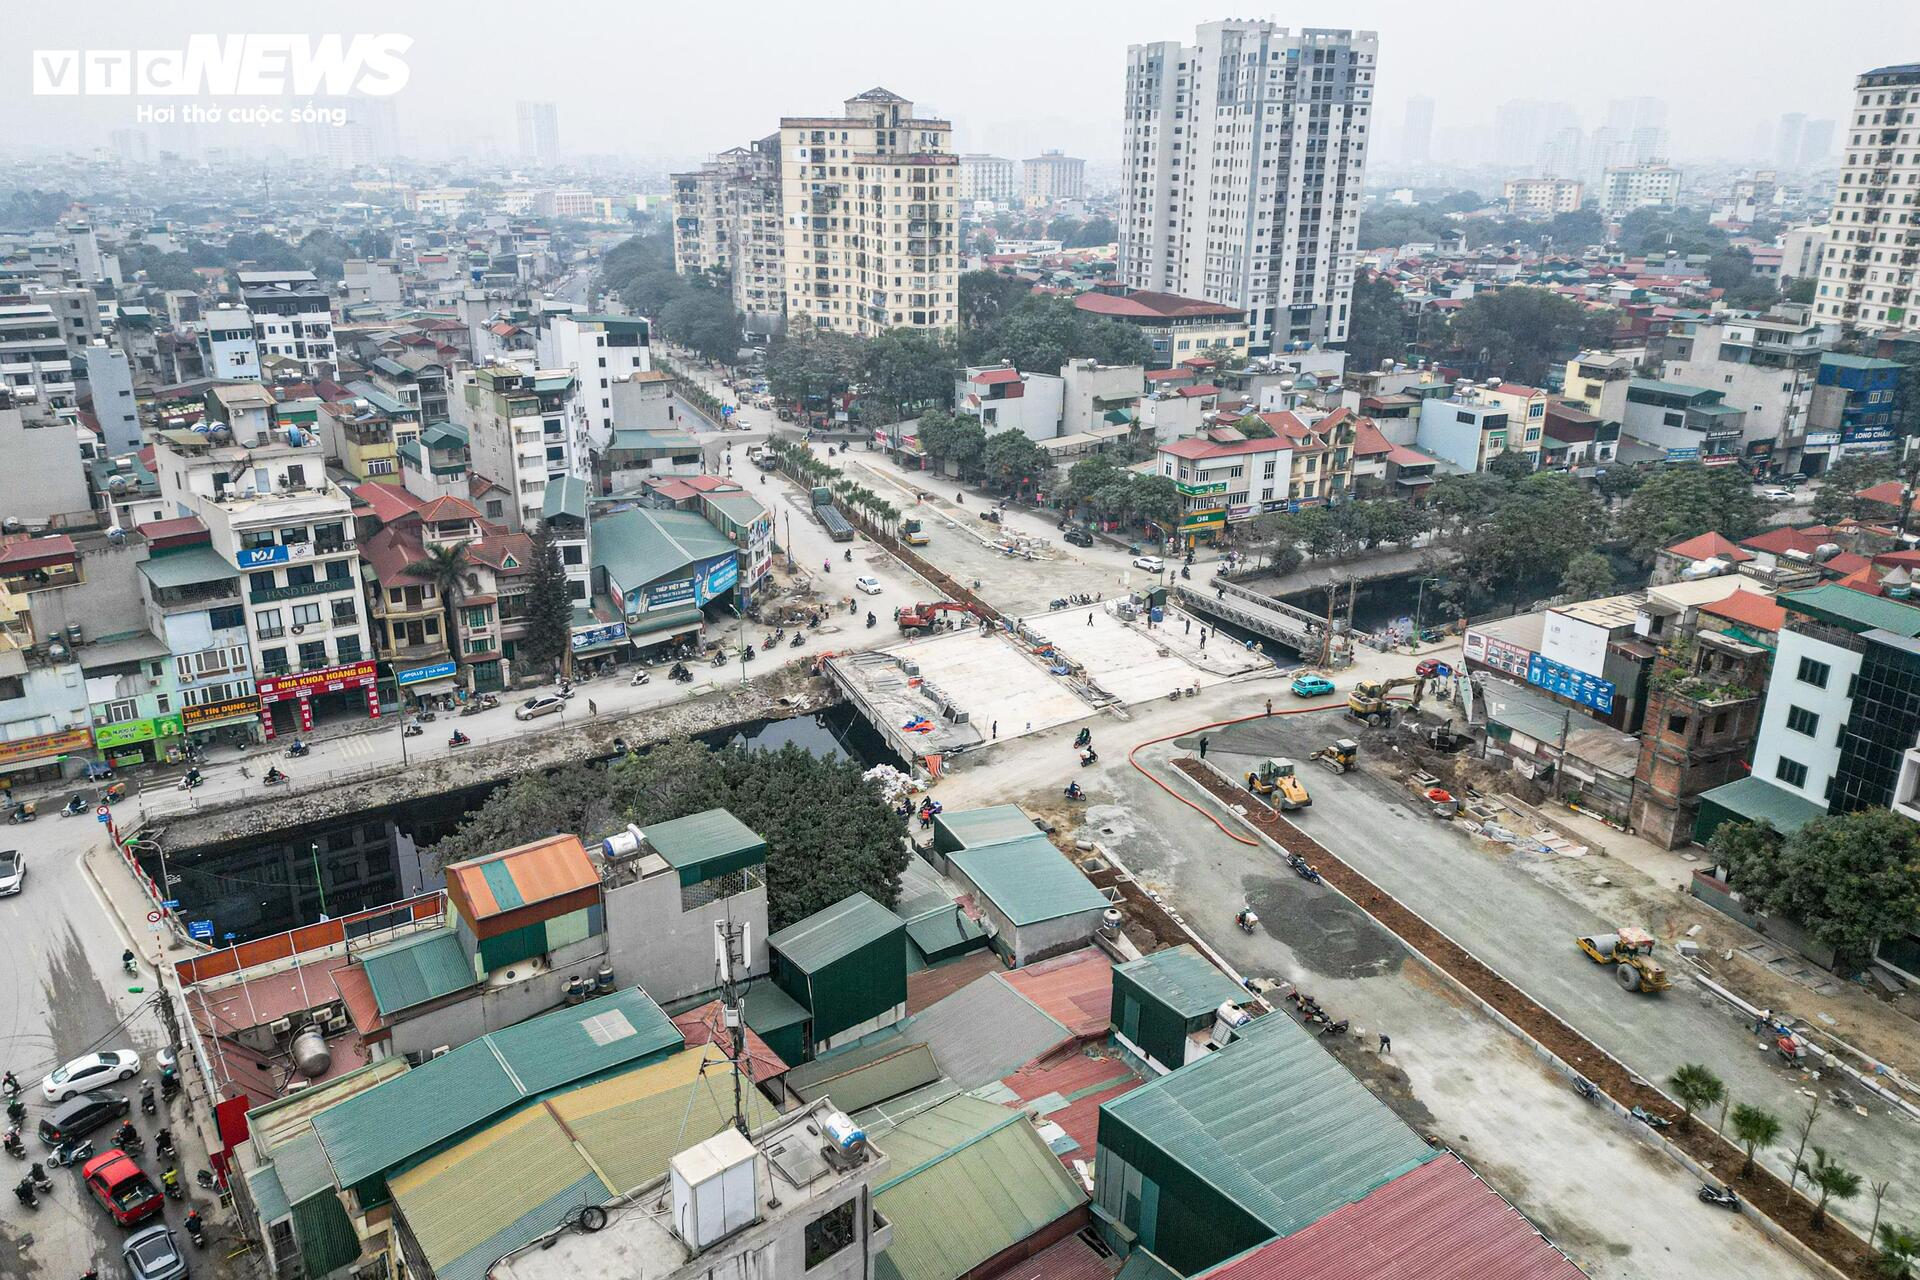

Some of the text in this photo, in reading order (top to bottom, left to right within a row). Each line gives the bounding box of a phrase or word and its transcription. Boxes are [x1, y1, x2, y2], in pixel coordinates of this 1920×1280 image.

[266, 581, 341, 600] HAND DECOR
[277, 681, 298, 690] NHA
[300, 676, 324, 686] KHOA
[358, 665, 373, 676] GIA
